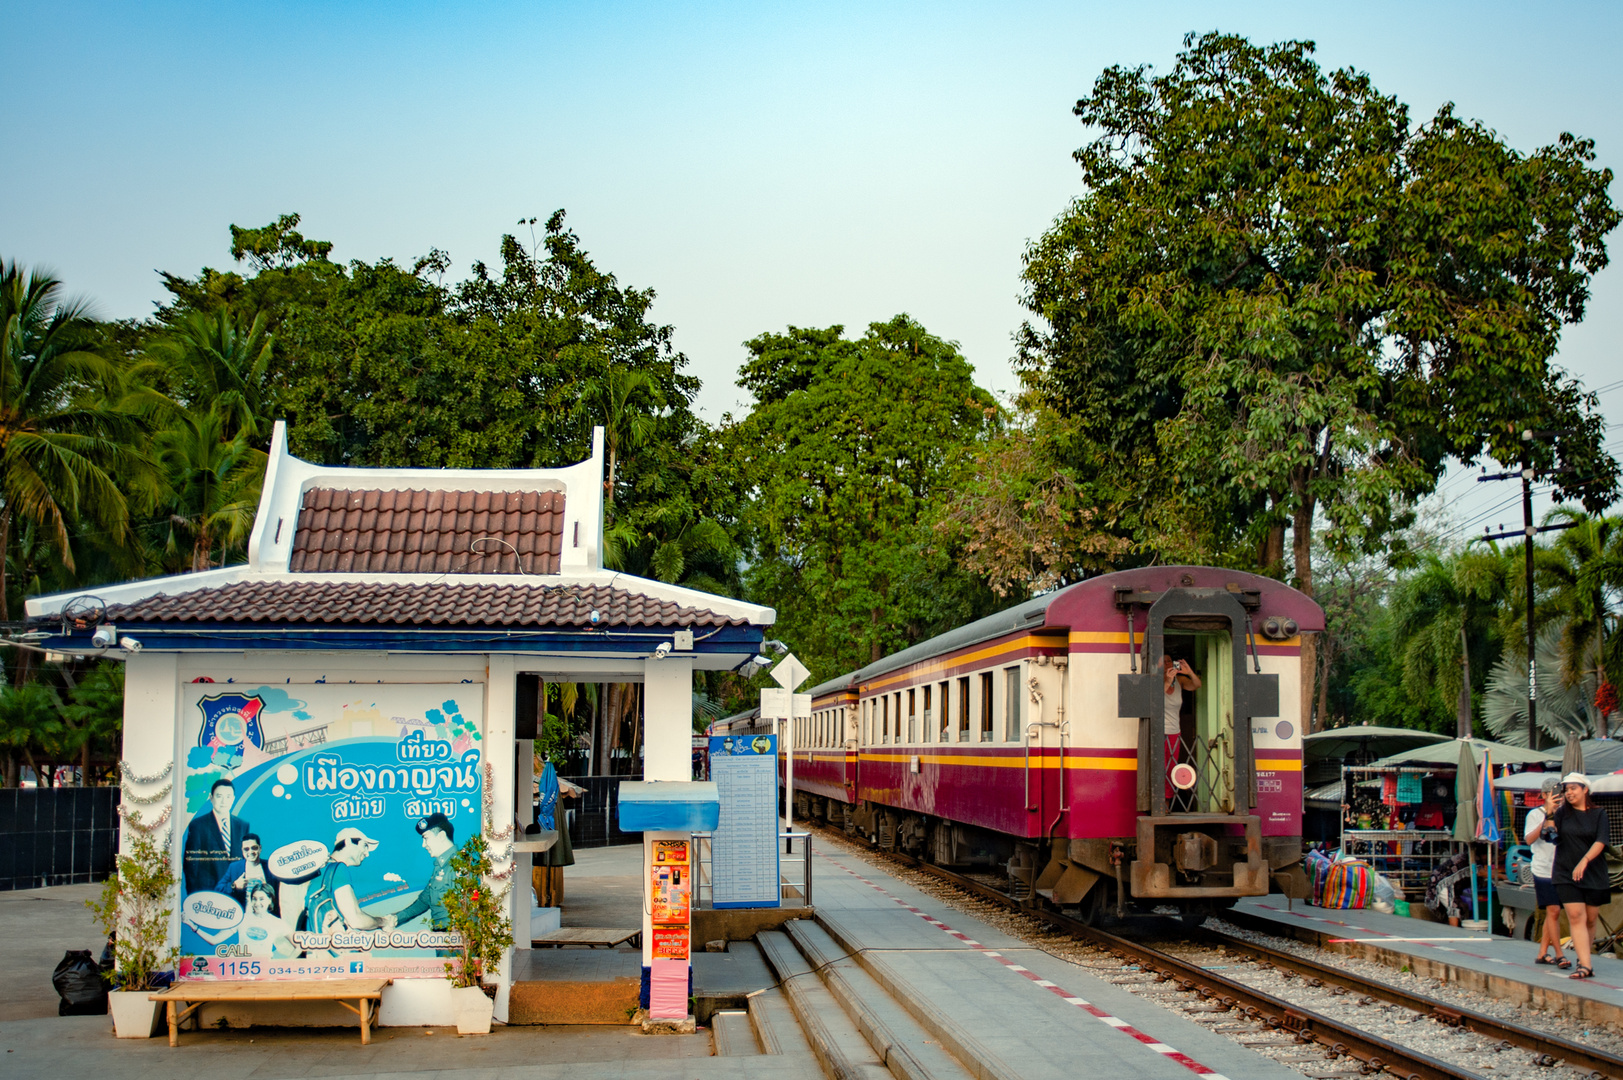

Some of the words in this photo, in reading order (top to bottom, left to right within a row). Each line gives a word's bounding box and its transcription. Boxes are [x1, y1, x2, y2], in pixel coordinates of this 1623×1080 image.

[401, 734, 448, 758] เที่ยว
[307, 754, 479, 795] เมืองกาญจน์
[334, 933, 372, 948] Safety
[377, 934, 387, 944] Is
[392, 933, 414, 944] Our
[419, 933, 462, 944] Concer
[215, 944, 252, 957] CALL
[218, 961, 261, 976] 1155
[269, 966, 345, 975] 034-512795
[421, 965, 447, 973] touris
